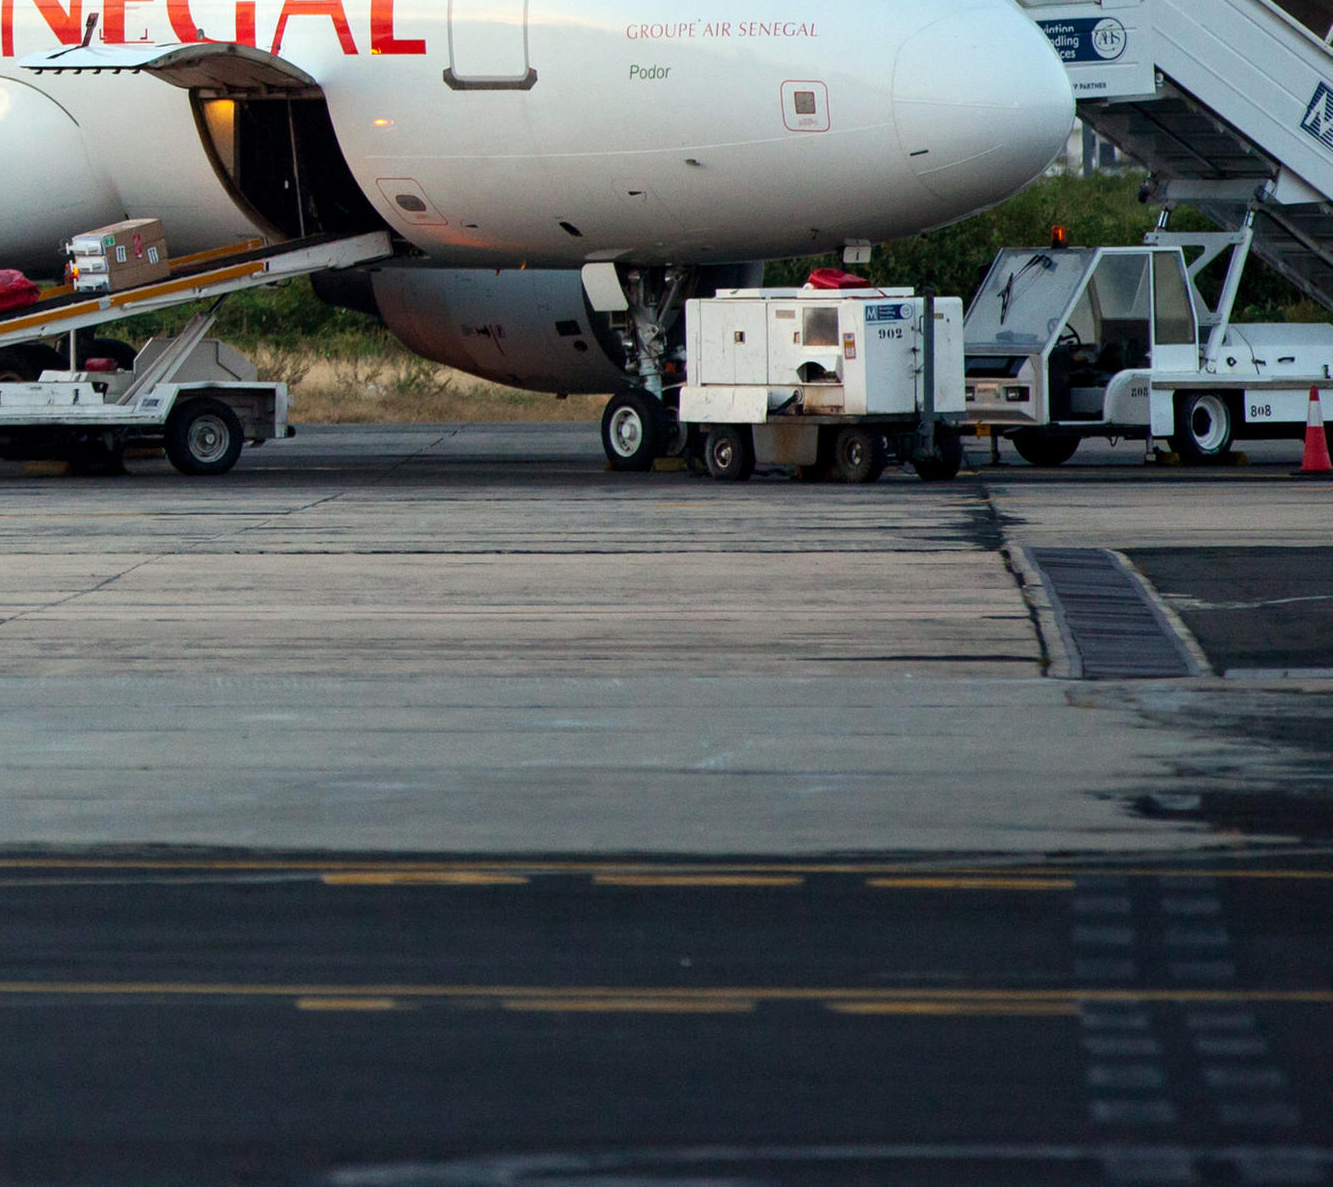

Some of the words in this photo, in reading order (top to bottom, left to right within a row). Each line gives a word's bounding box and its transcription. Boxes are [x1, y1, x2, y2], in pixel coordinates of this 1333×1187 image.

[626, 22, 696, 40] GROUPE
[702, 21, 732, 37] AIR
[738, 21, 819, 38] SENEGAL
[629, 64, 671, 80] Podor
[878, 328, 903, 339] 902
[1250, 405, 1272, 417] 808
